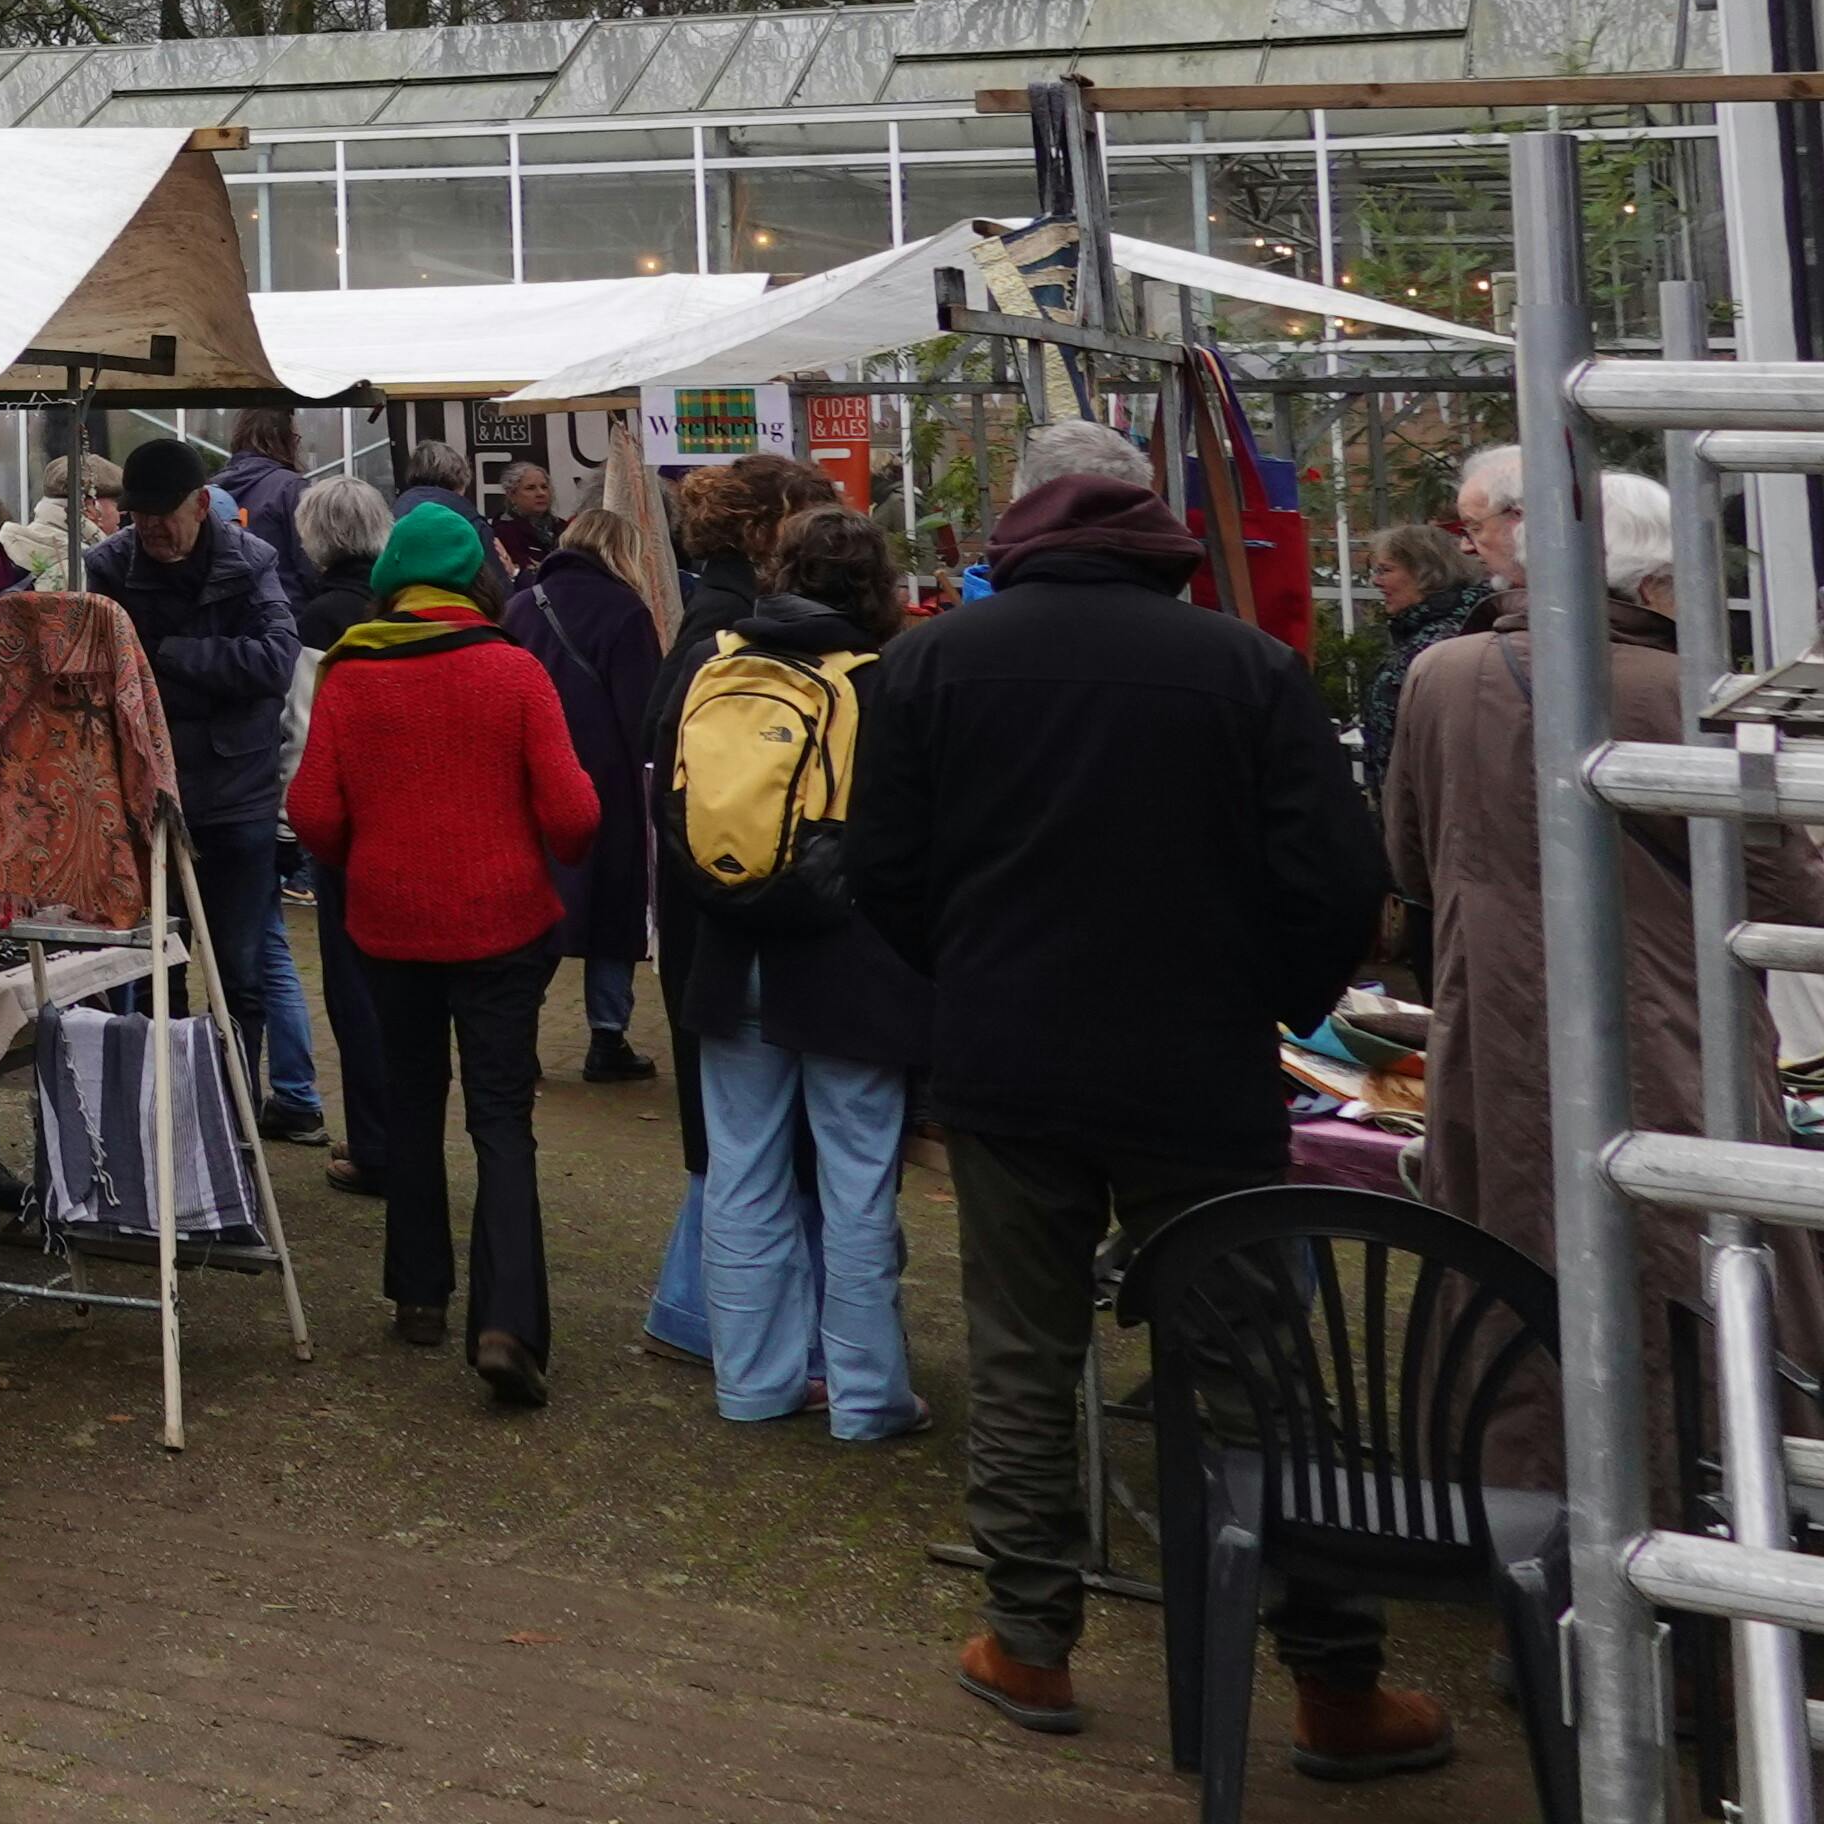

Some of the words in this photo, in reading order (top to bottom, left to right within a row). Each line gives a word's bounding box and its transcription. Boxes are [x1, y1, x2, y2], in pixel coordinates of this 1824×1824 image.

[814, 398, 866, 418] CIDER
[479, 425, 490, 441] &
[493, 425, 526, 441] ALES
[815, 420, 827, 436] &
[832, 419, 866, 436] ALES
